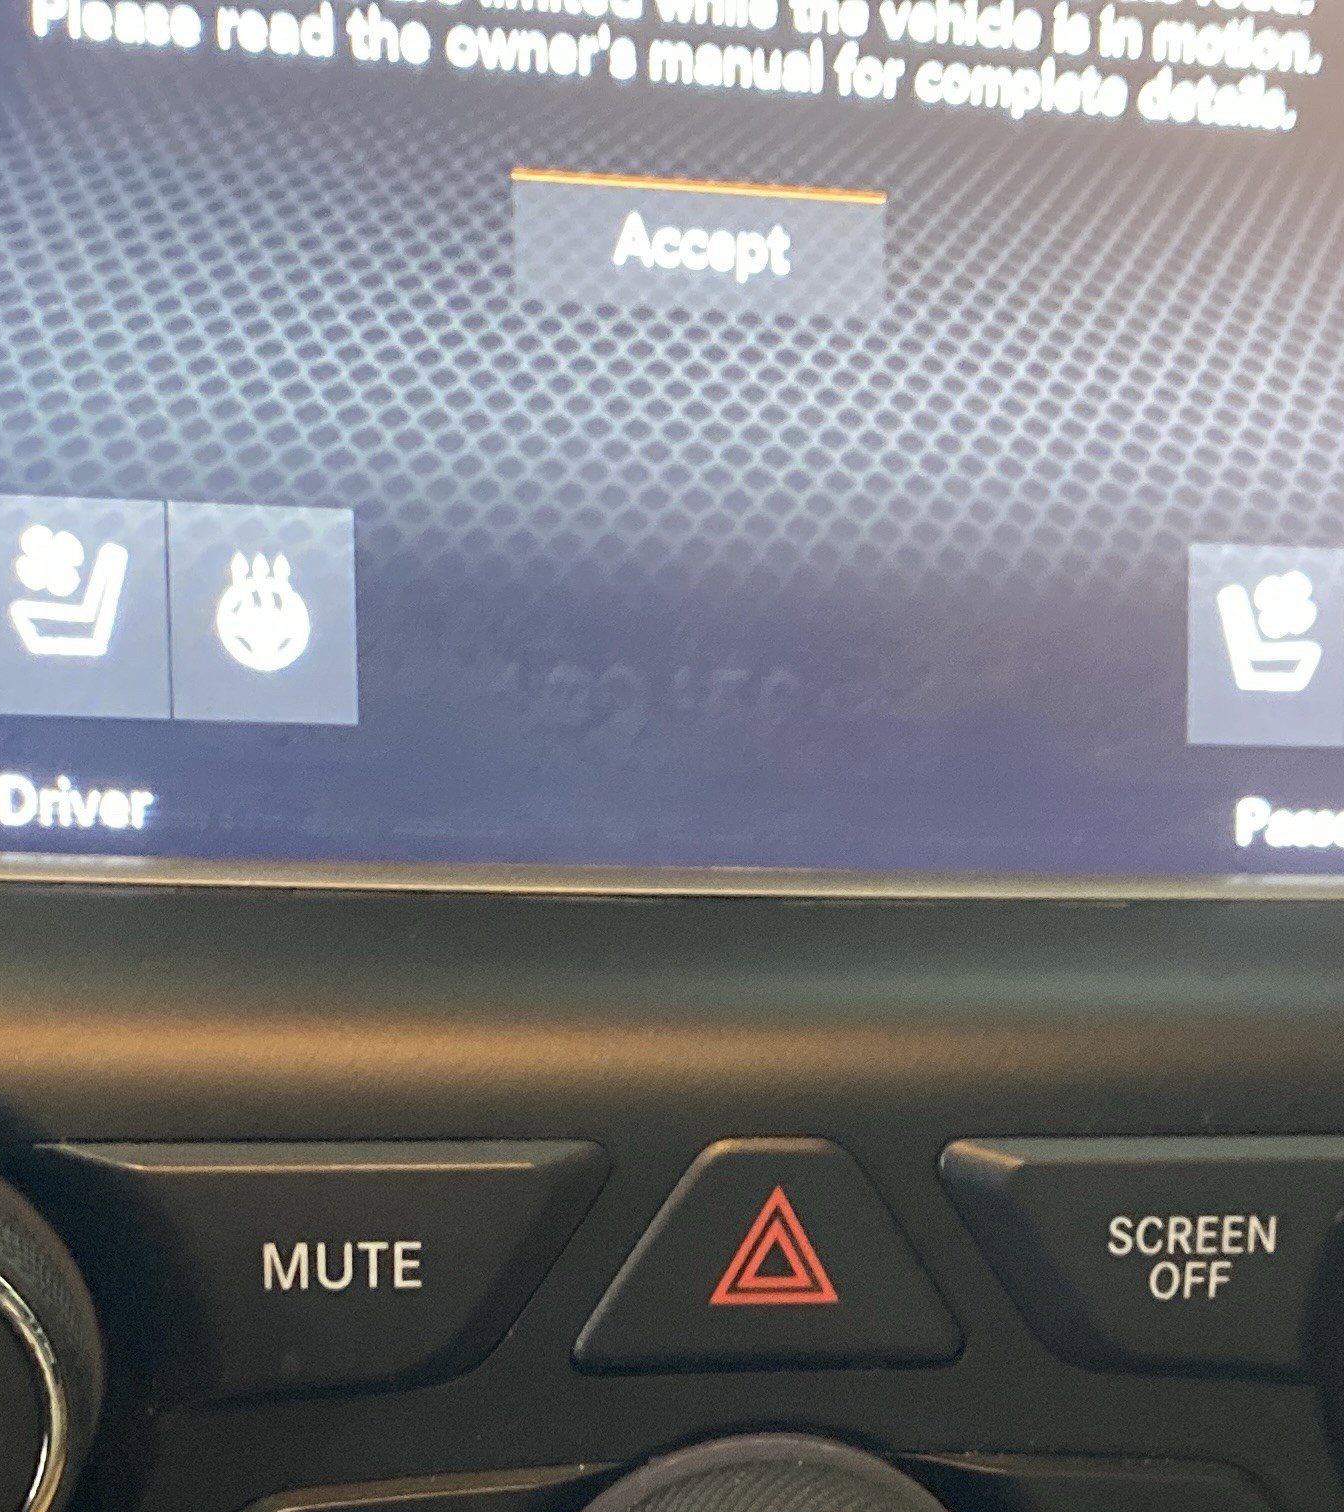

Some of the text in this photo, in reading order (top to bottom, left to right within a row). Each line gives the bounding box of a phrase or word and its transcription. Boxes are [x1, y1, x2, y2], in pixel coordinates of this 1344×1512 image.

[32, 0, 1297, 130] Please read the owner's manual for complete details.
[788, 0, 869, 37] the
[879, 0, 1042, 50] vehicle
[1053, 0, 1091, 55] is
[1099, 4, 1144, 60] in
[1152, 16, 1324, 75] motion.
[612, 210, 792, 284] Accept
[261, 1240, 423, 1291] MUTE
[1108, 1215, 1277, 1255] SCREEN
[1149, 1261, 1232, 1300] OFF
